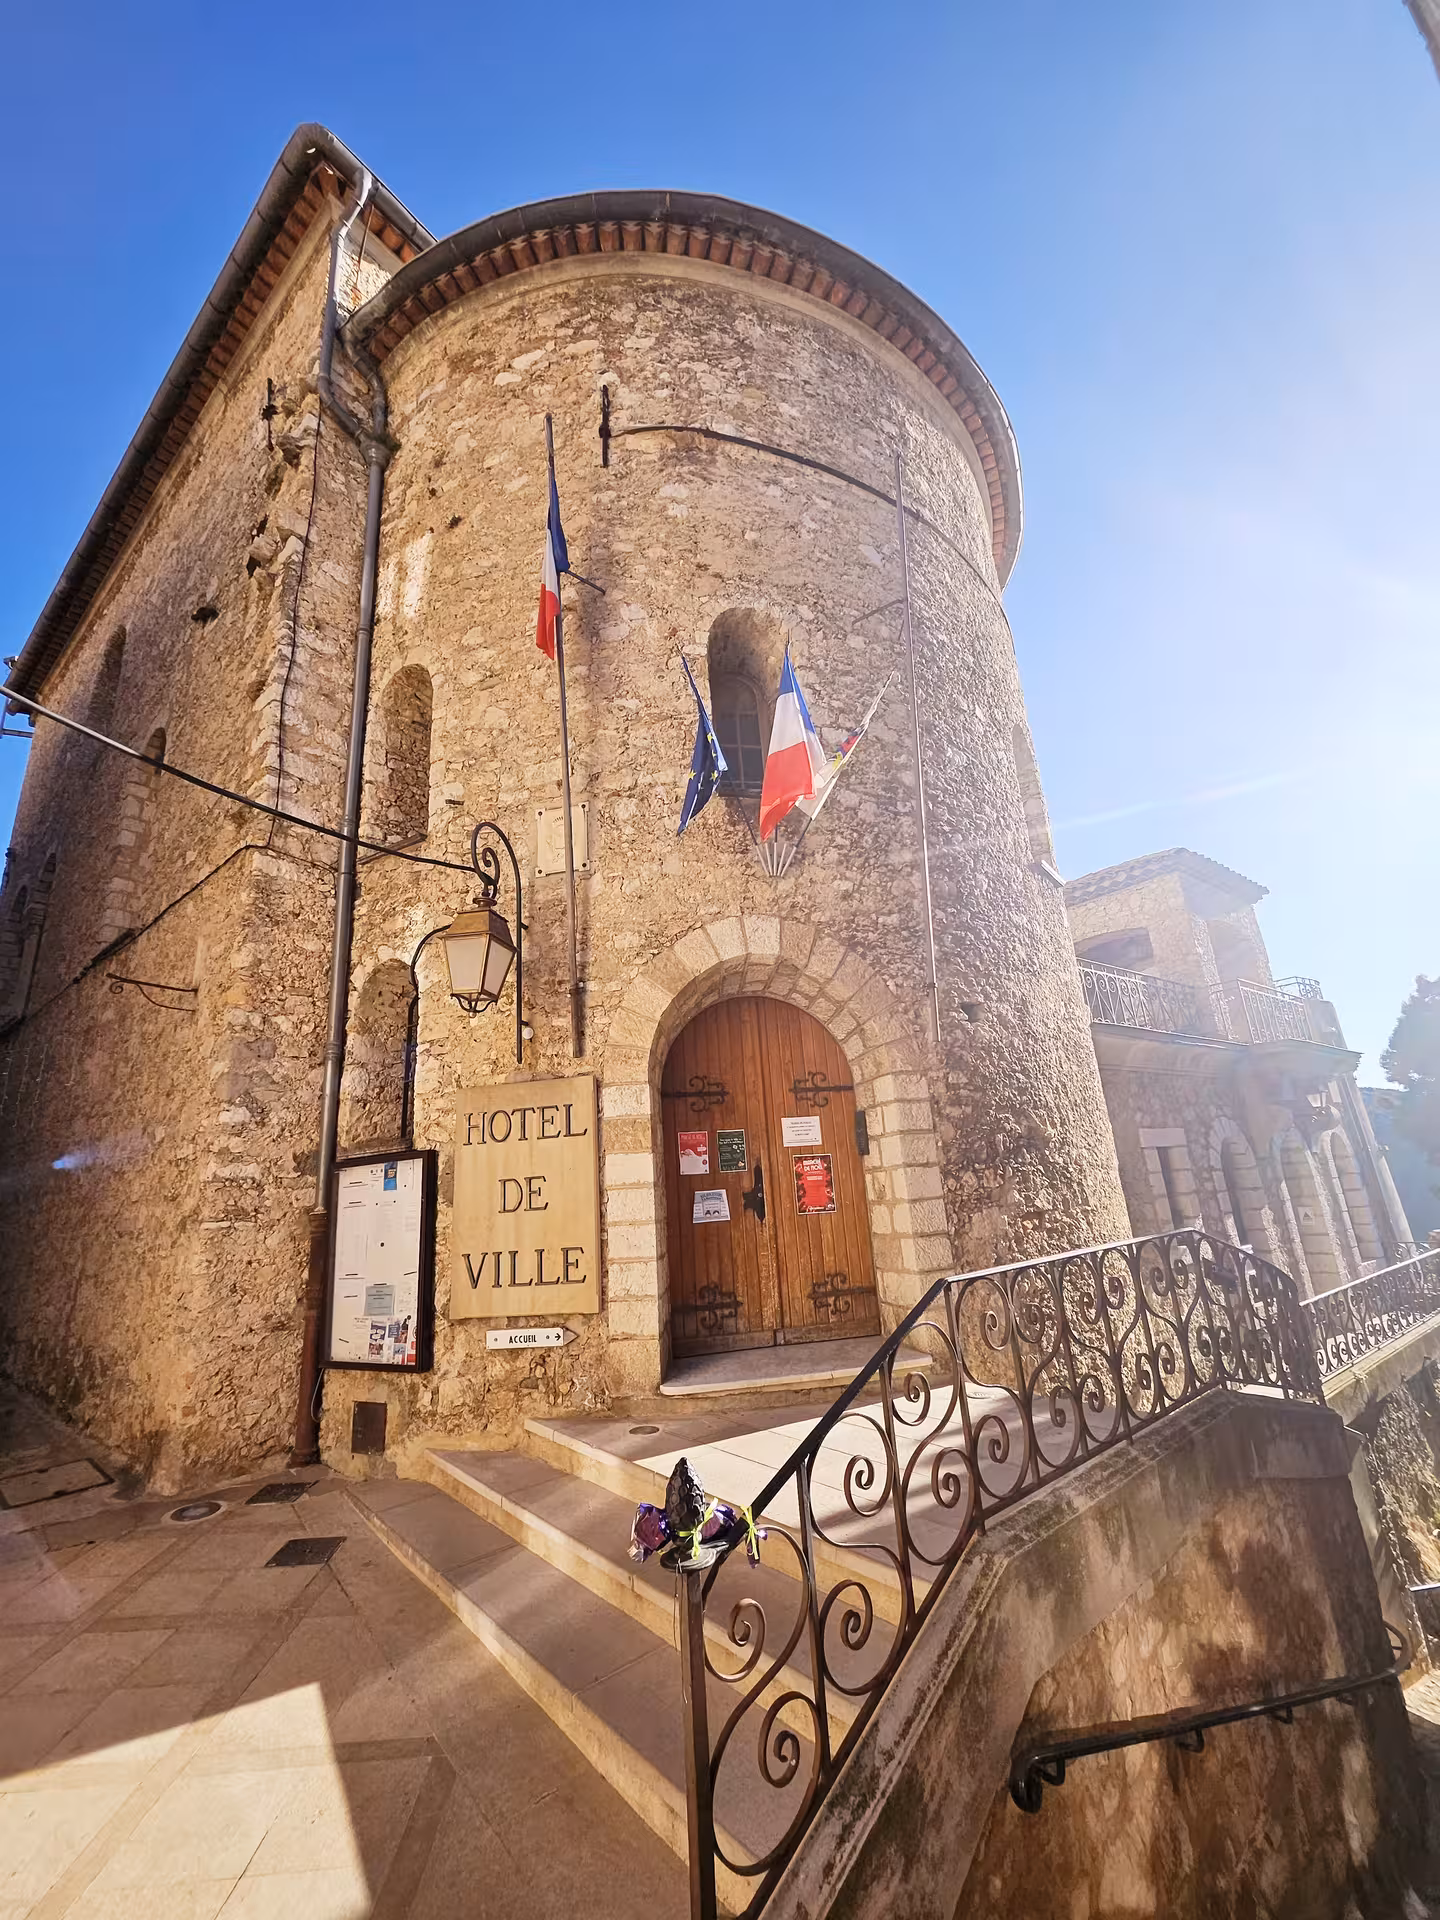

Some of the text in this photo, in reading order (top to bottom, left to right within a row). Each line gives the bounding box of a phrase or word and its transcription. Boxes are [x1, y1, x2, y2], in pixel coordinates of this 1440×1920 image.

[463, 1103, 588, 1146] HOTEL
[498, 1175, 549, 1214] DE
[461, 1246, 587, 1290] VILLE
[508, 1334, 537, 1344] ACCUEIL
